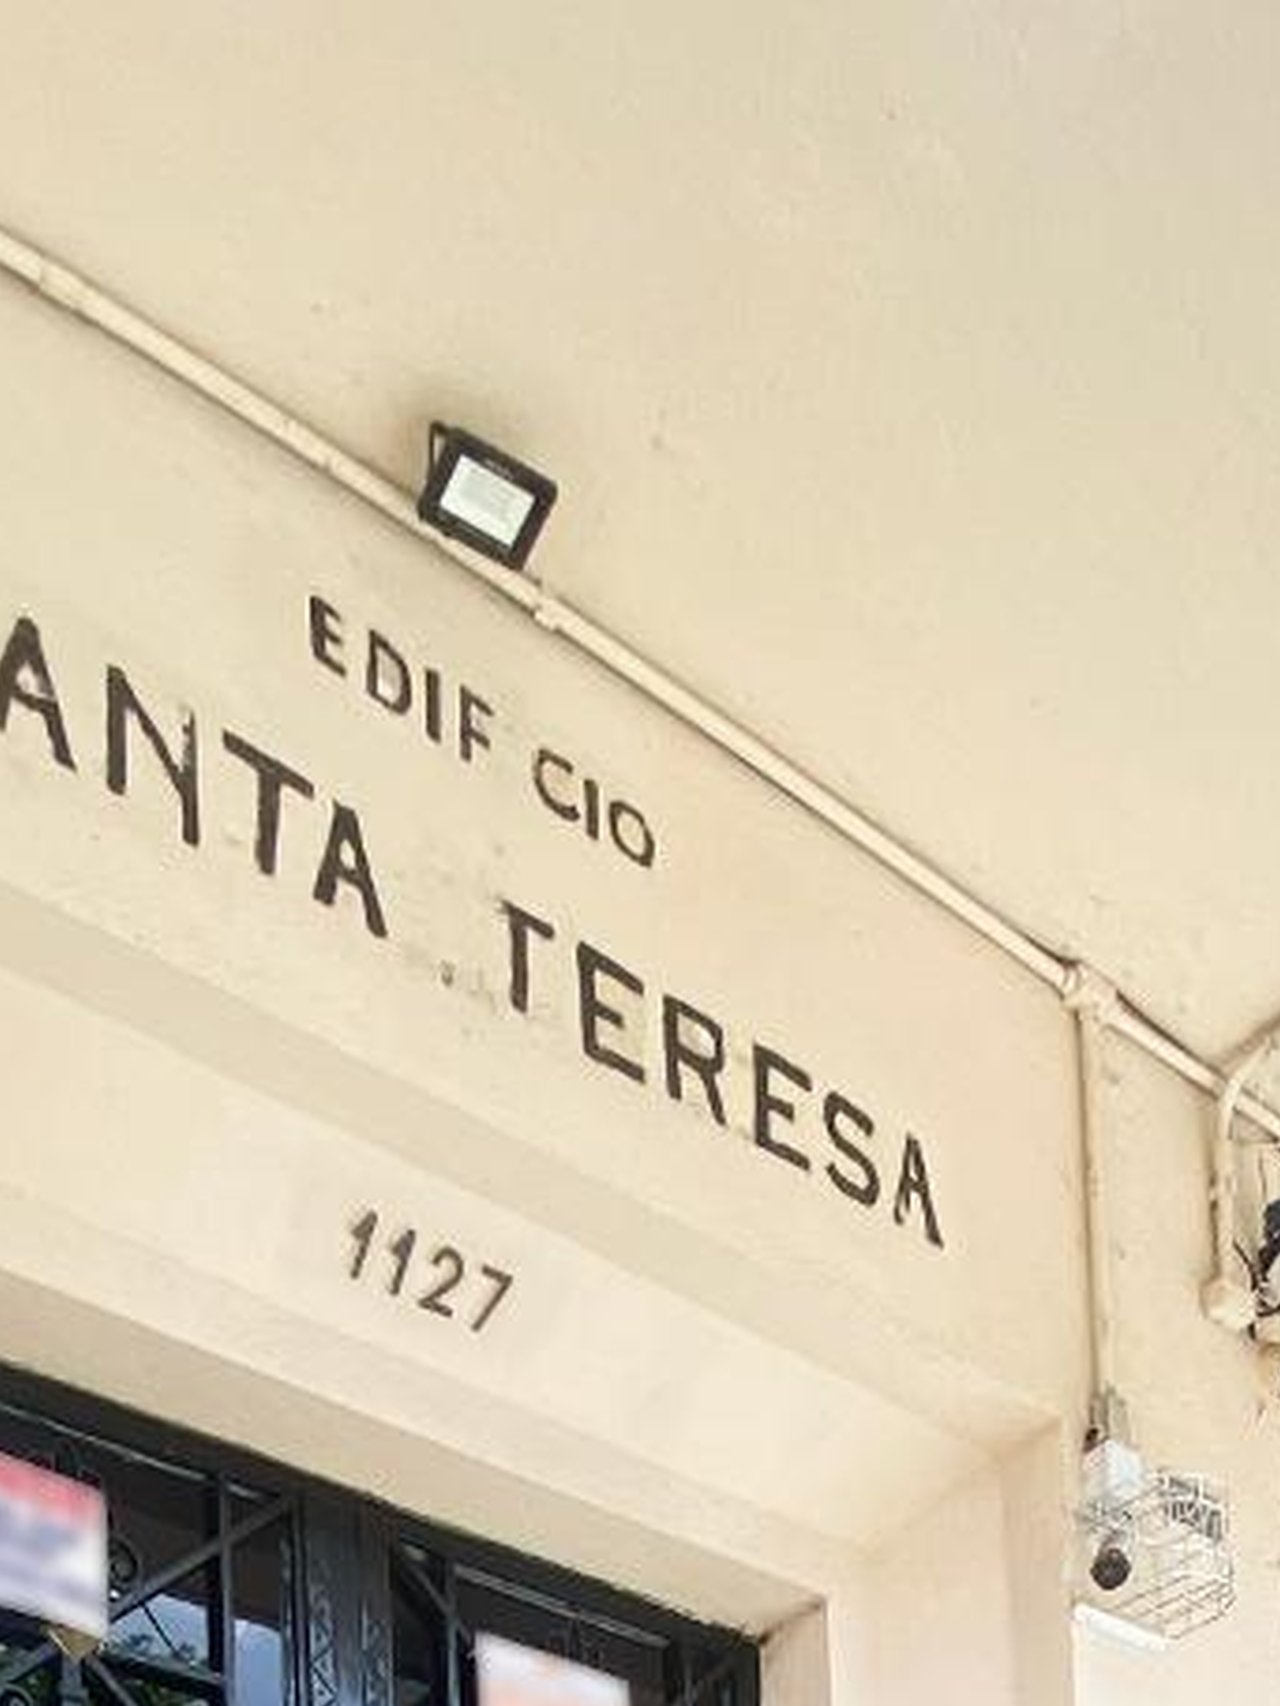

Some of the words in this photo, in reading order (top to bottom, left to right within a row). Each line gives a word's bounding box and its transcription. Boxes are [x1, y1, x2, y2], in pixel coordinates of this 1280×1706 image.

[308, 594, 656, 870] EDIFCIO
[500, 901, 944, 1249] TERESA
[348, 1209, 514, 1332] 1127
